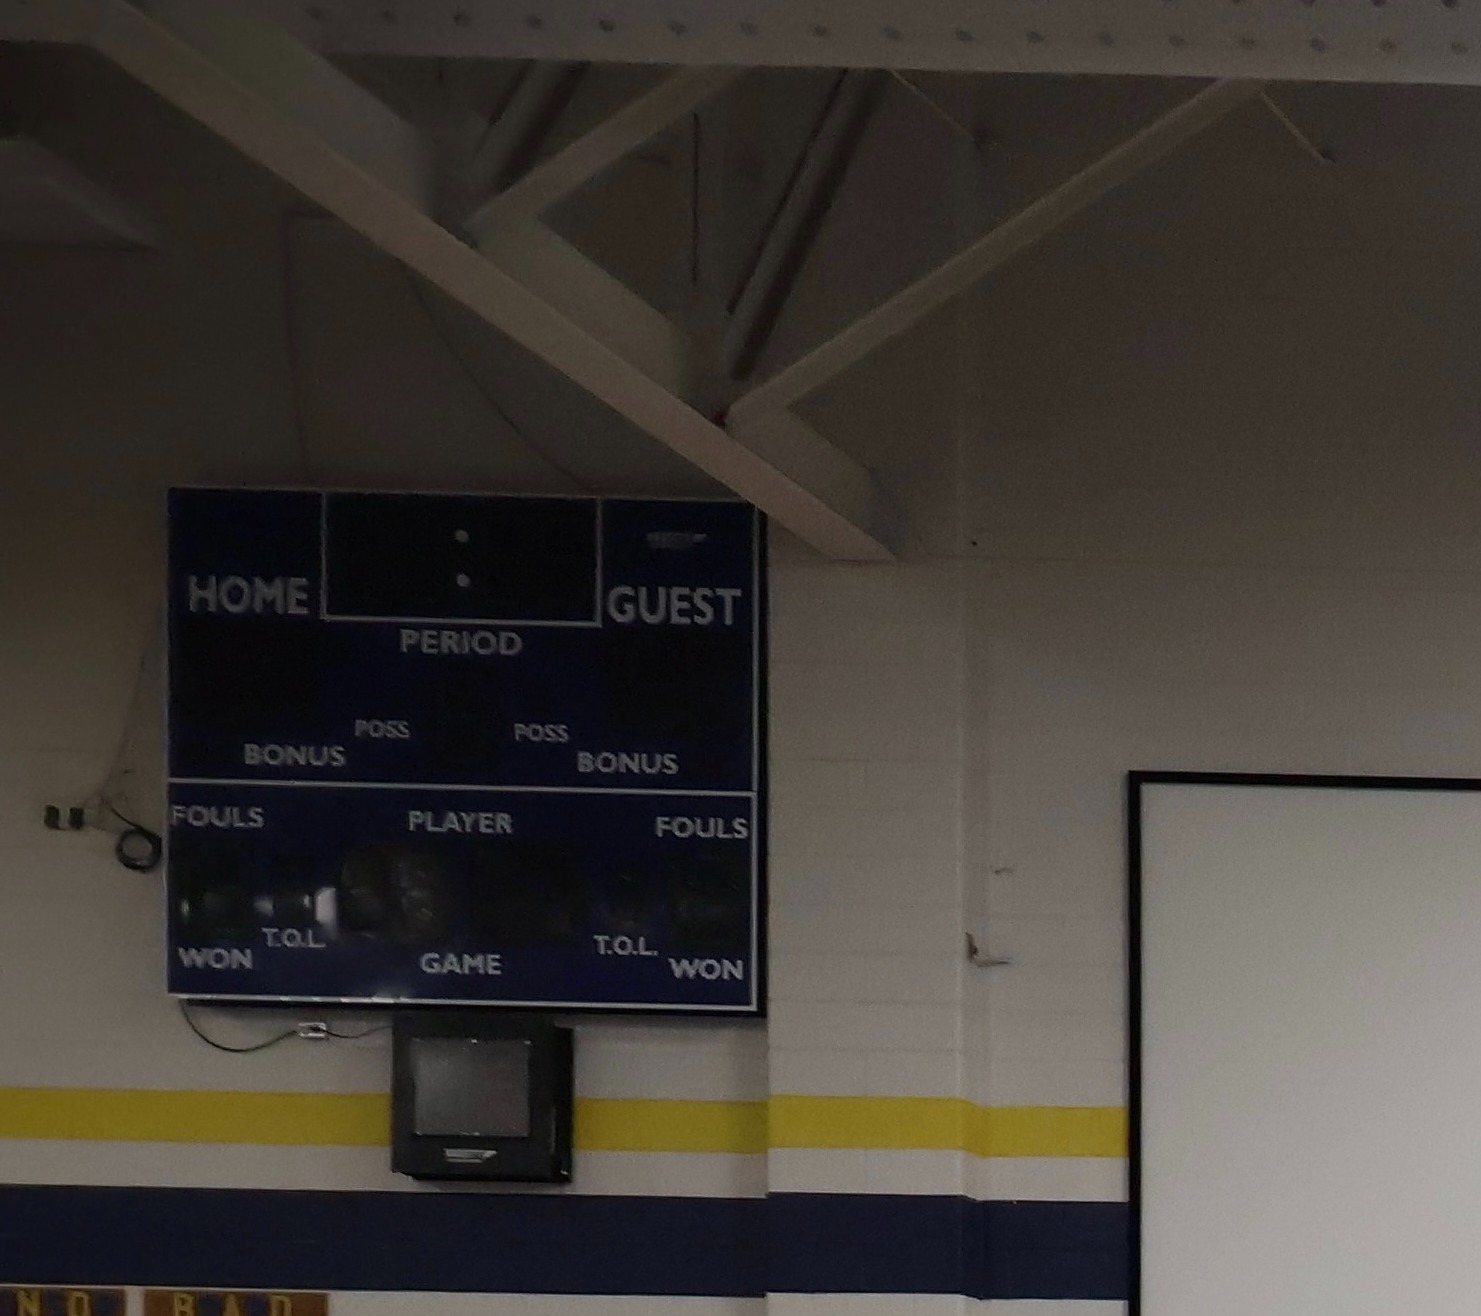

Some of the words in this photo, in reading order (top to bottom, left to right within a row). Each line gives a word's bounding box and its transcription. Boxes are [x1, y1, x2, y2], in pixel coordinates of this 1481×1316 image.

[188, 574, 310, 615] HOME
[607, 585, 742, 625] GUEST
[400, 629, 522, 656] PERIOD
[354, 719, 410, 738] POSS
[514, 723, 570, 743] POSS
[244, 743, 346, 767] BONUS
[577, 751, 680, 775] BONUS
[172, 804, 265, 828] FOULS
[407, 810, 513, 834] PLAYER
[655, 816, 749, 840] FOULS
[178, 948, 254, 971] WON
[419, 952, 502, 975] GAME
[668, 957, 744, 981] WON
